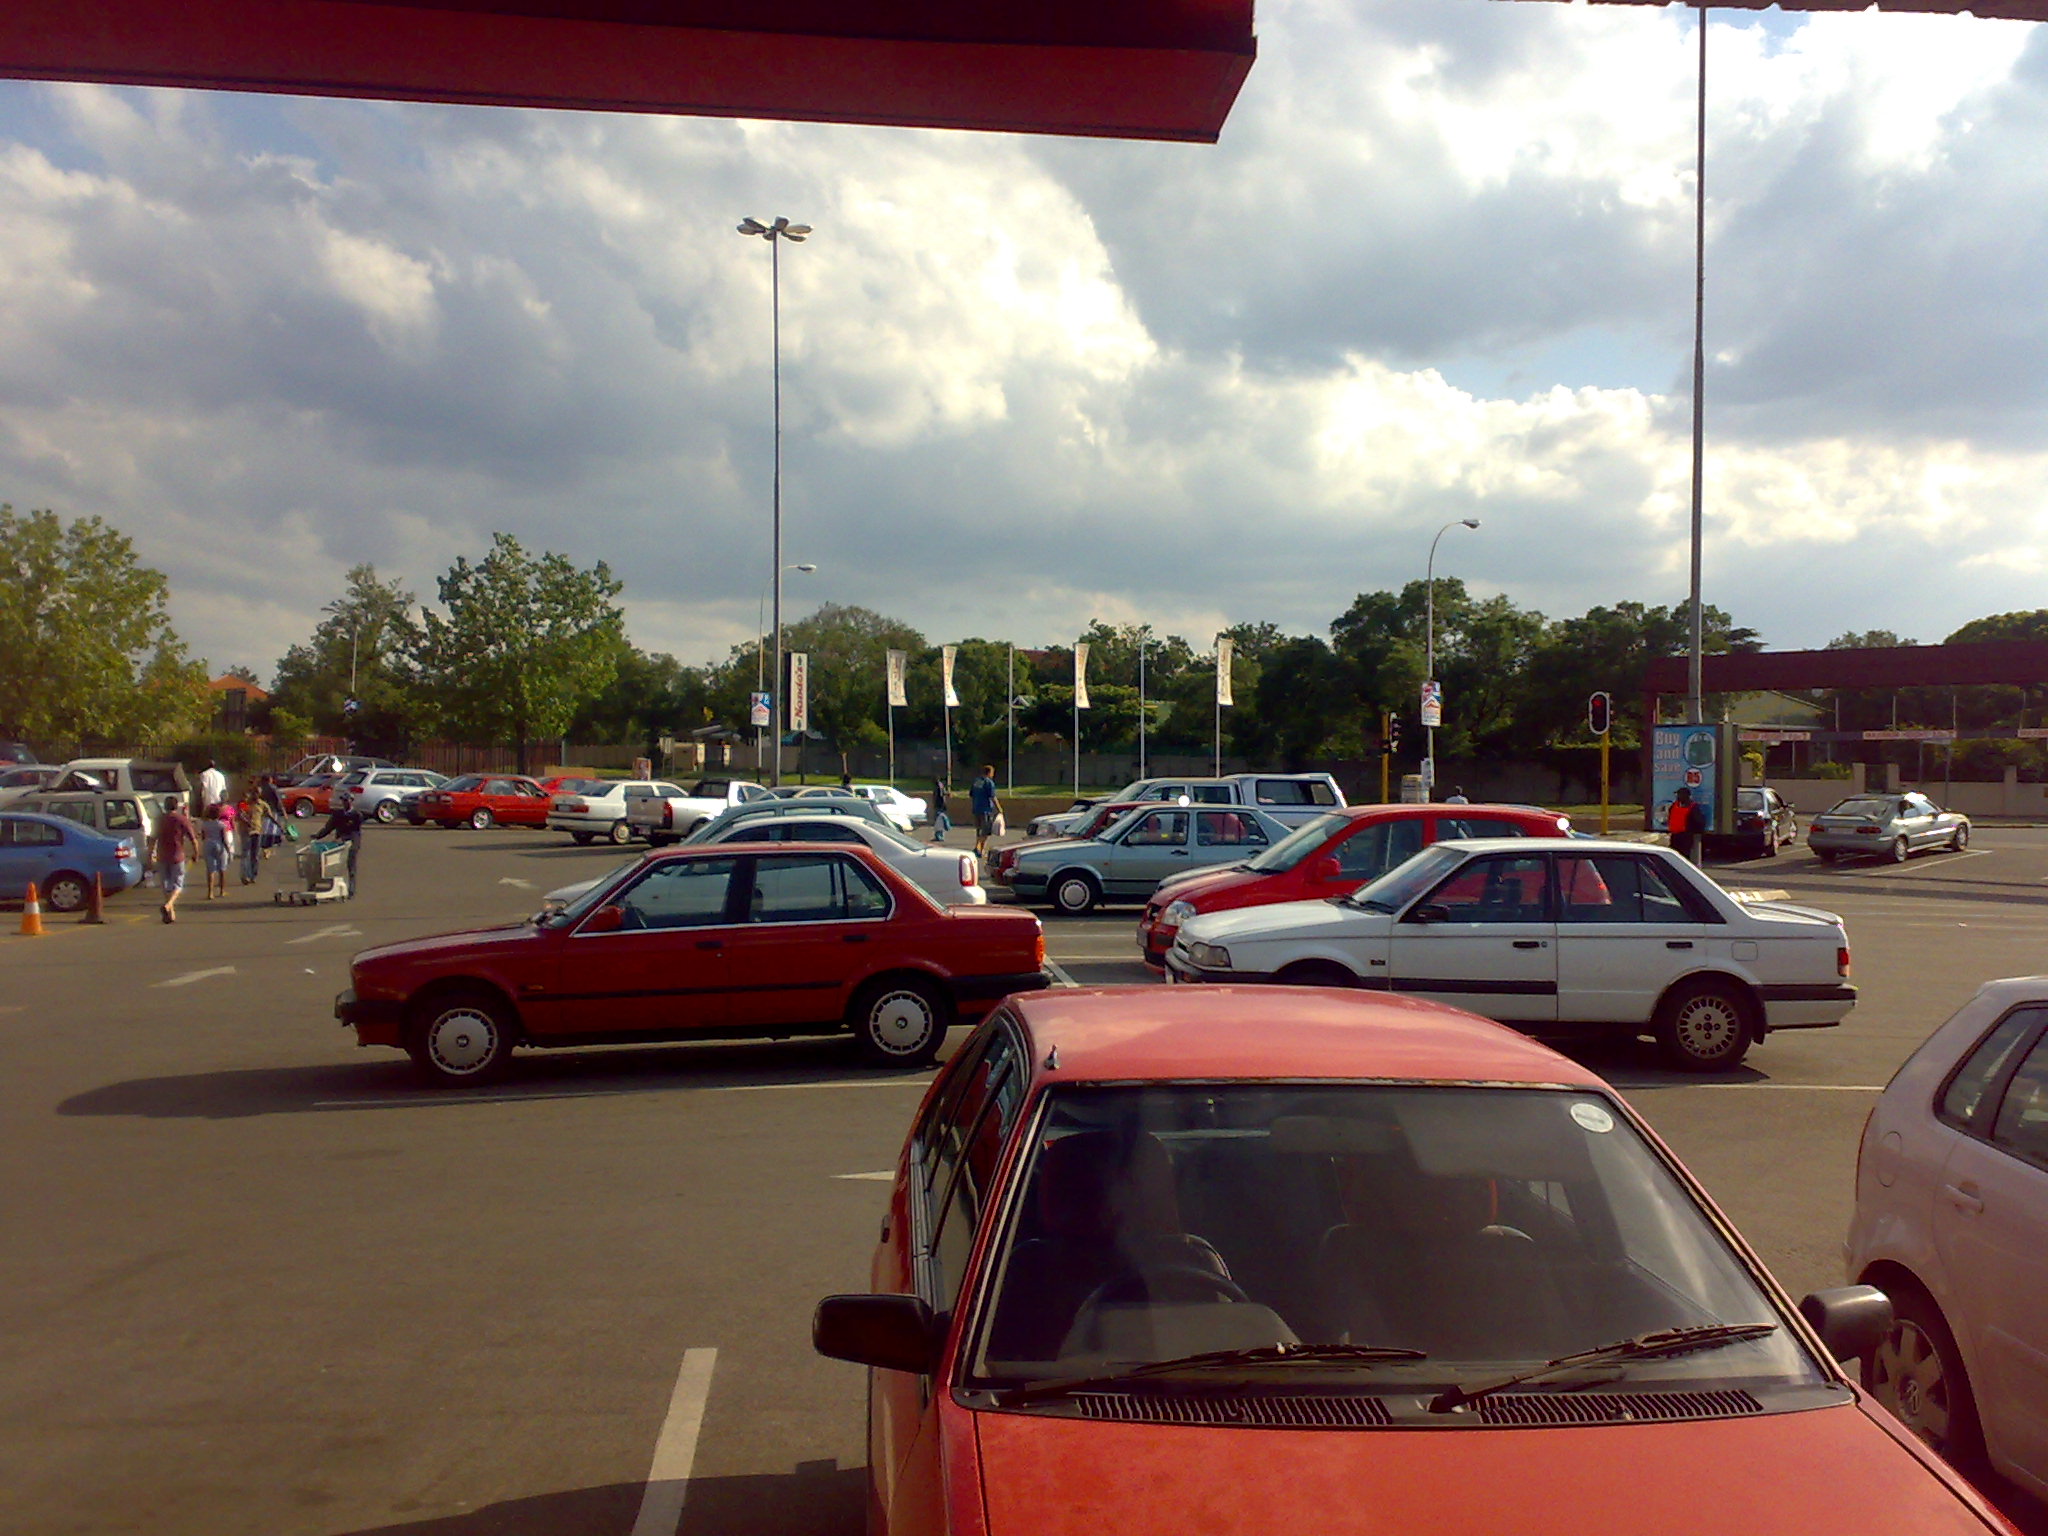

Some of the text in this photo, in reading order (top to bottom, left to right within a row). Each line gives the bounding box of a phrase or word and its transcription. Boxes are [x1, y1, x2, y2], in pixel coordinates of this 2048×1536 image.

[795, 667, 803, 718] Nando's
[1656, 732, 1680, 747] Buy
[1656, 748, 1680, 759] and
[1655, 762, 1681, 772] save
